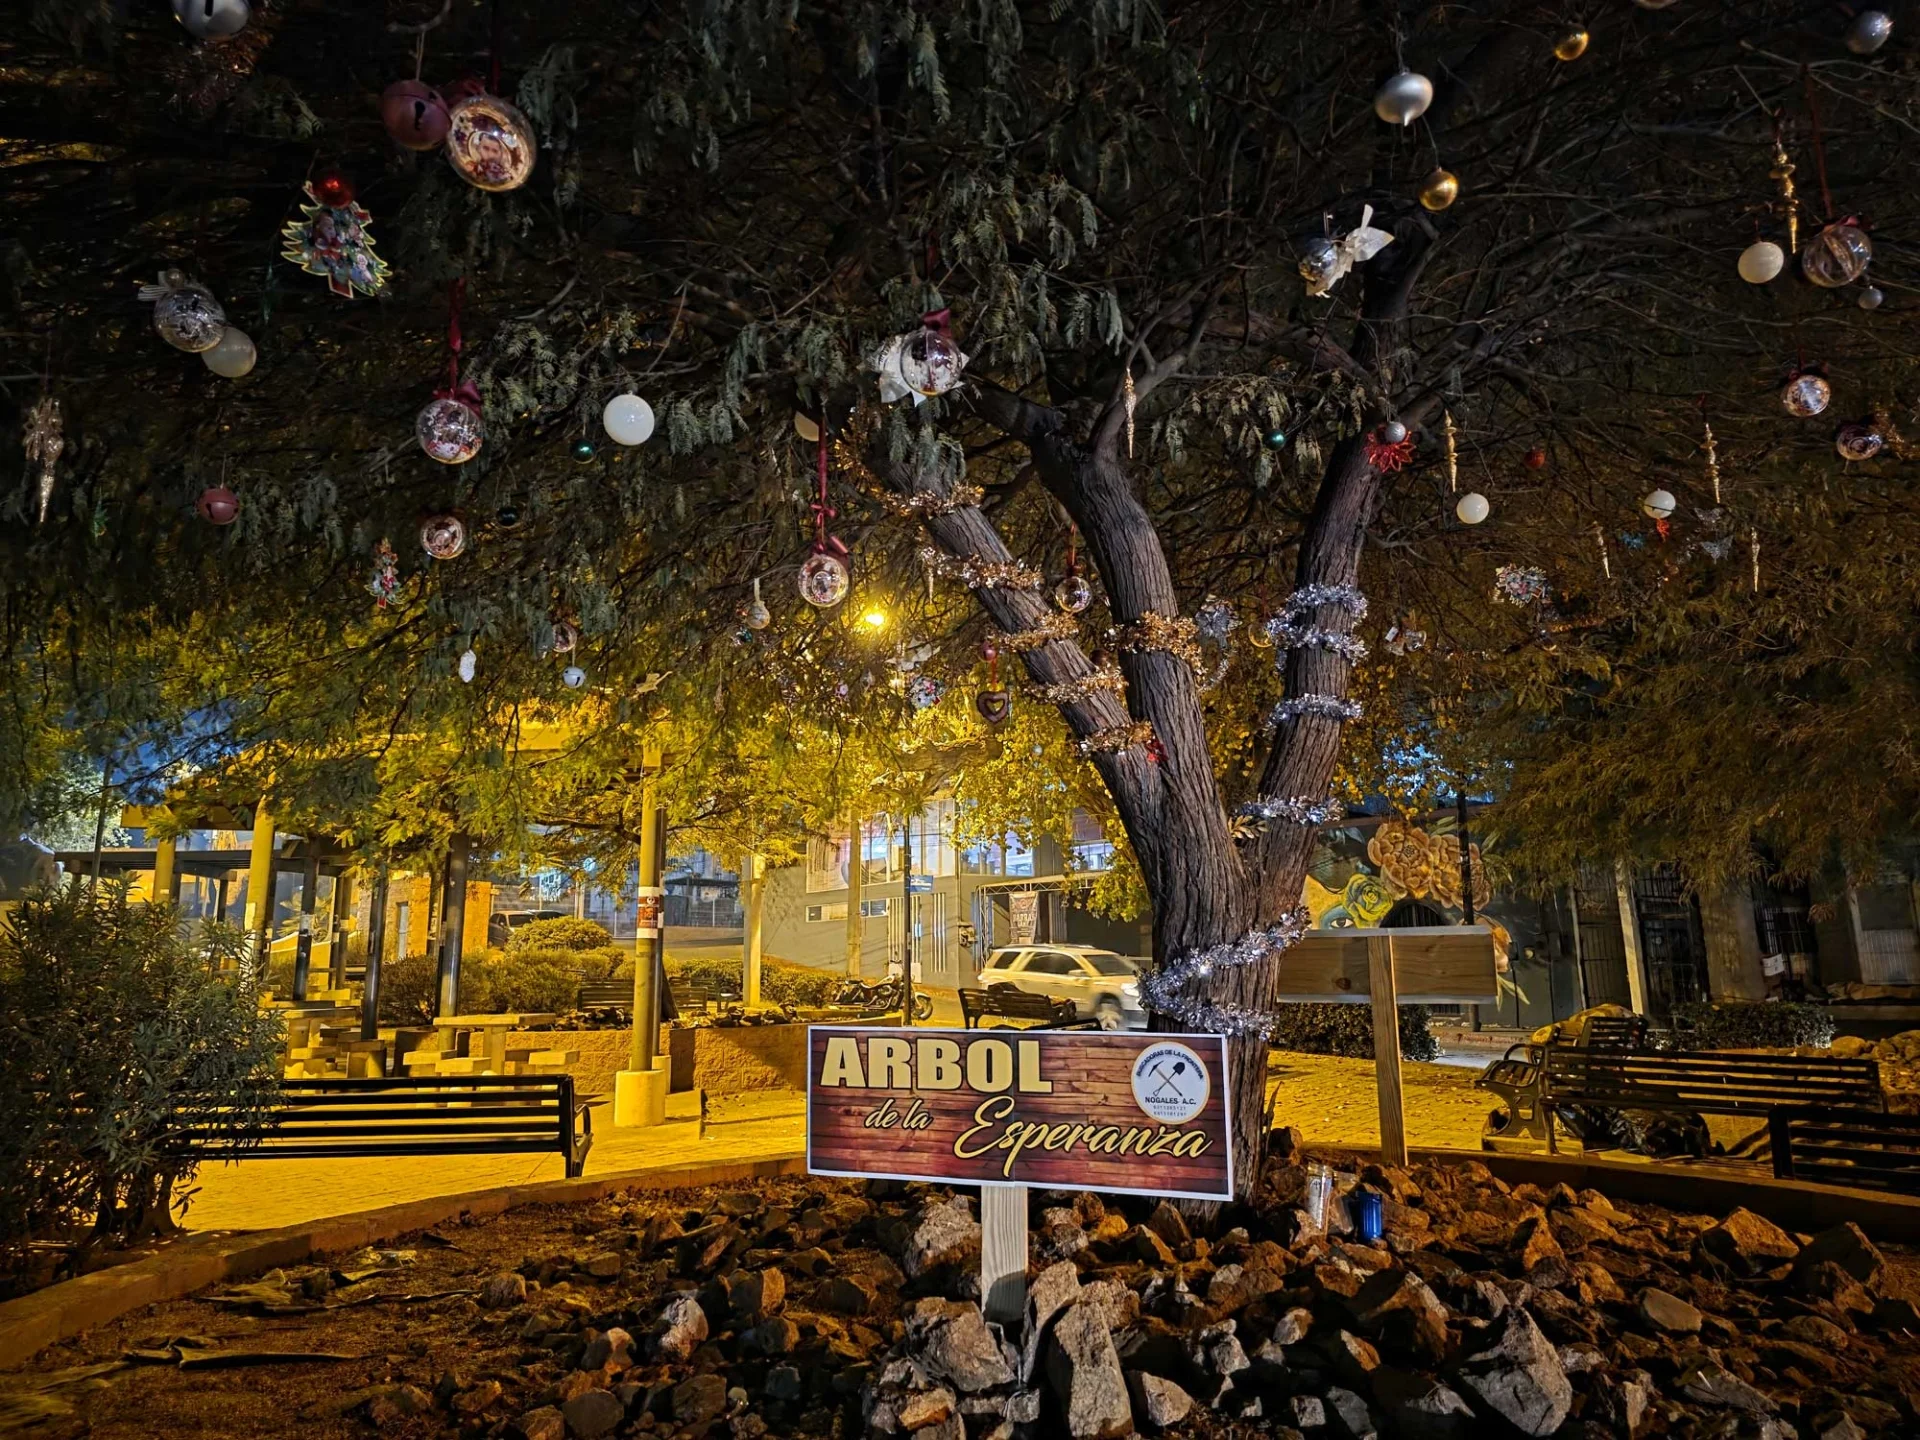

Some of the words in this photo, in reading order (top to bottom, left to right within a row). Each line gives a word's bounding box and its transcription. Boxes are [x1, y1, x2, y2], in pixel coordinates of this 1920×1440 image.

[820, 1036, 1053, 1093] ARBOL
[1173, 1050, 1181, 1058] LA
[864, 1098, 897, 1128] de
[903, 1101, 932, 1130] la
[1145, 1096, 1179, 1104] NOGALES
[953, 1095, 1213, 1178] Esperanza
